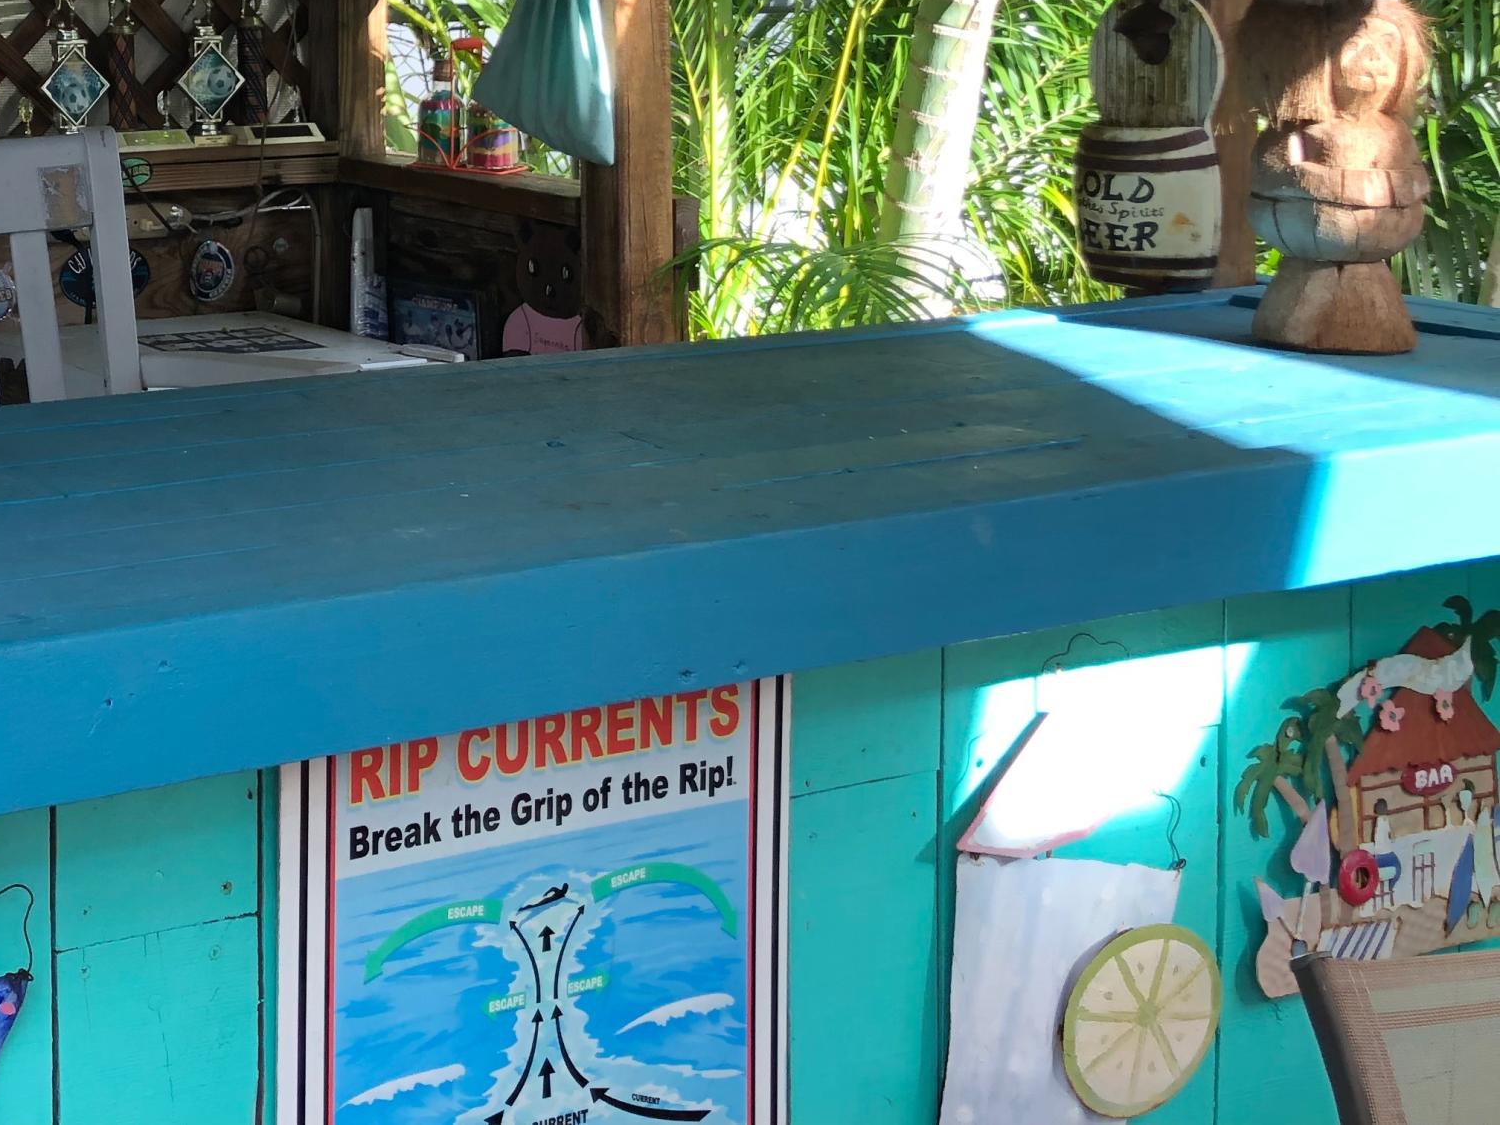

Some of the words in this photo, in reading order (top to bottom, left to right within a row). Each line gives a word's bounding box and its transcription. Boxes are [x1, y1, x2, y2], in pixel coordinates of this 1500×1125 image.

[1080, 170, 1155, 204] OLD
[1083, 217, 1159, 252] EER
[348, 735, 440, 805] RIP
[456, 682, 740, 784] CURRENTS
[349, 812, 442, 861] Break
[451, 803, 501, 839] the
[510, 787, 573, 826] Grip
[582, 776, 612, 813] of
[621, 771, 669, 806] the
[678, 755, 735, 797] Rip!
[610, 867, 647, 888] ESCAPE
[447, 904, 485, 920] ESCAPE
[567, 975, 604, 994] ESCAPE
[488, 994, 525, 1014] ESCAPE
[631, 1092, 662, 1106] CURRENT
